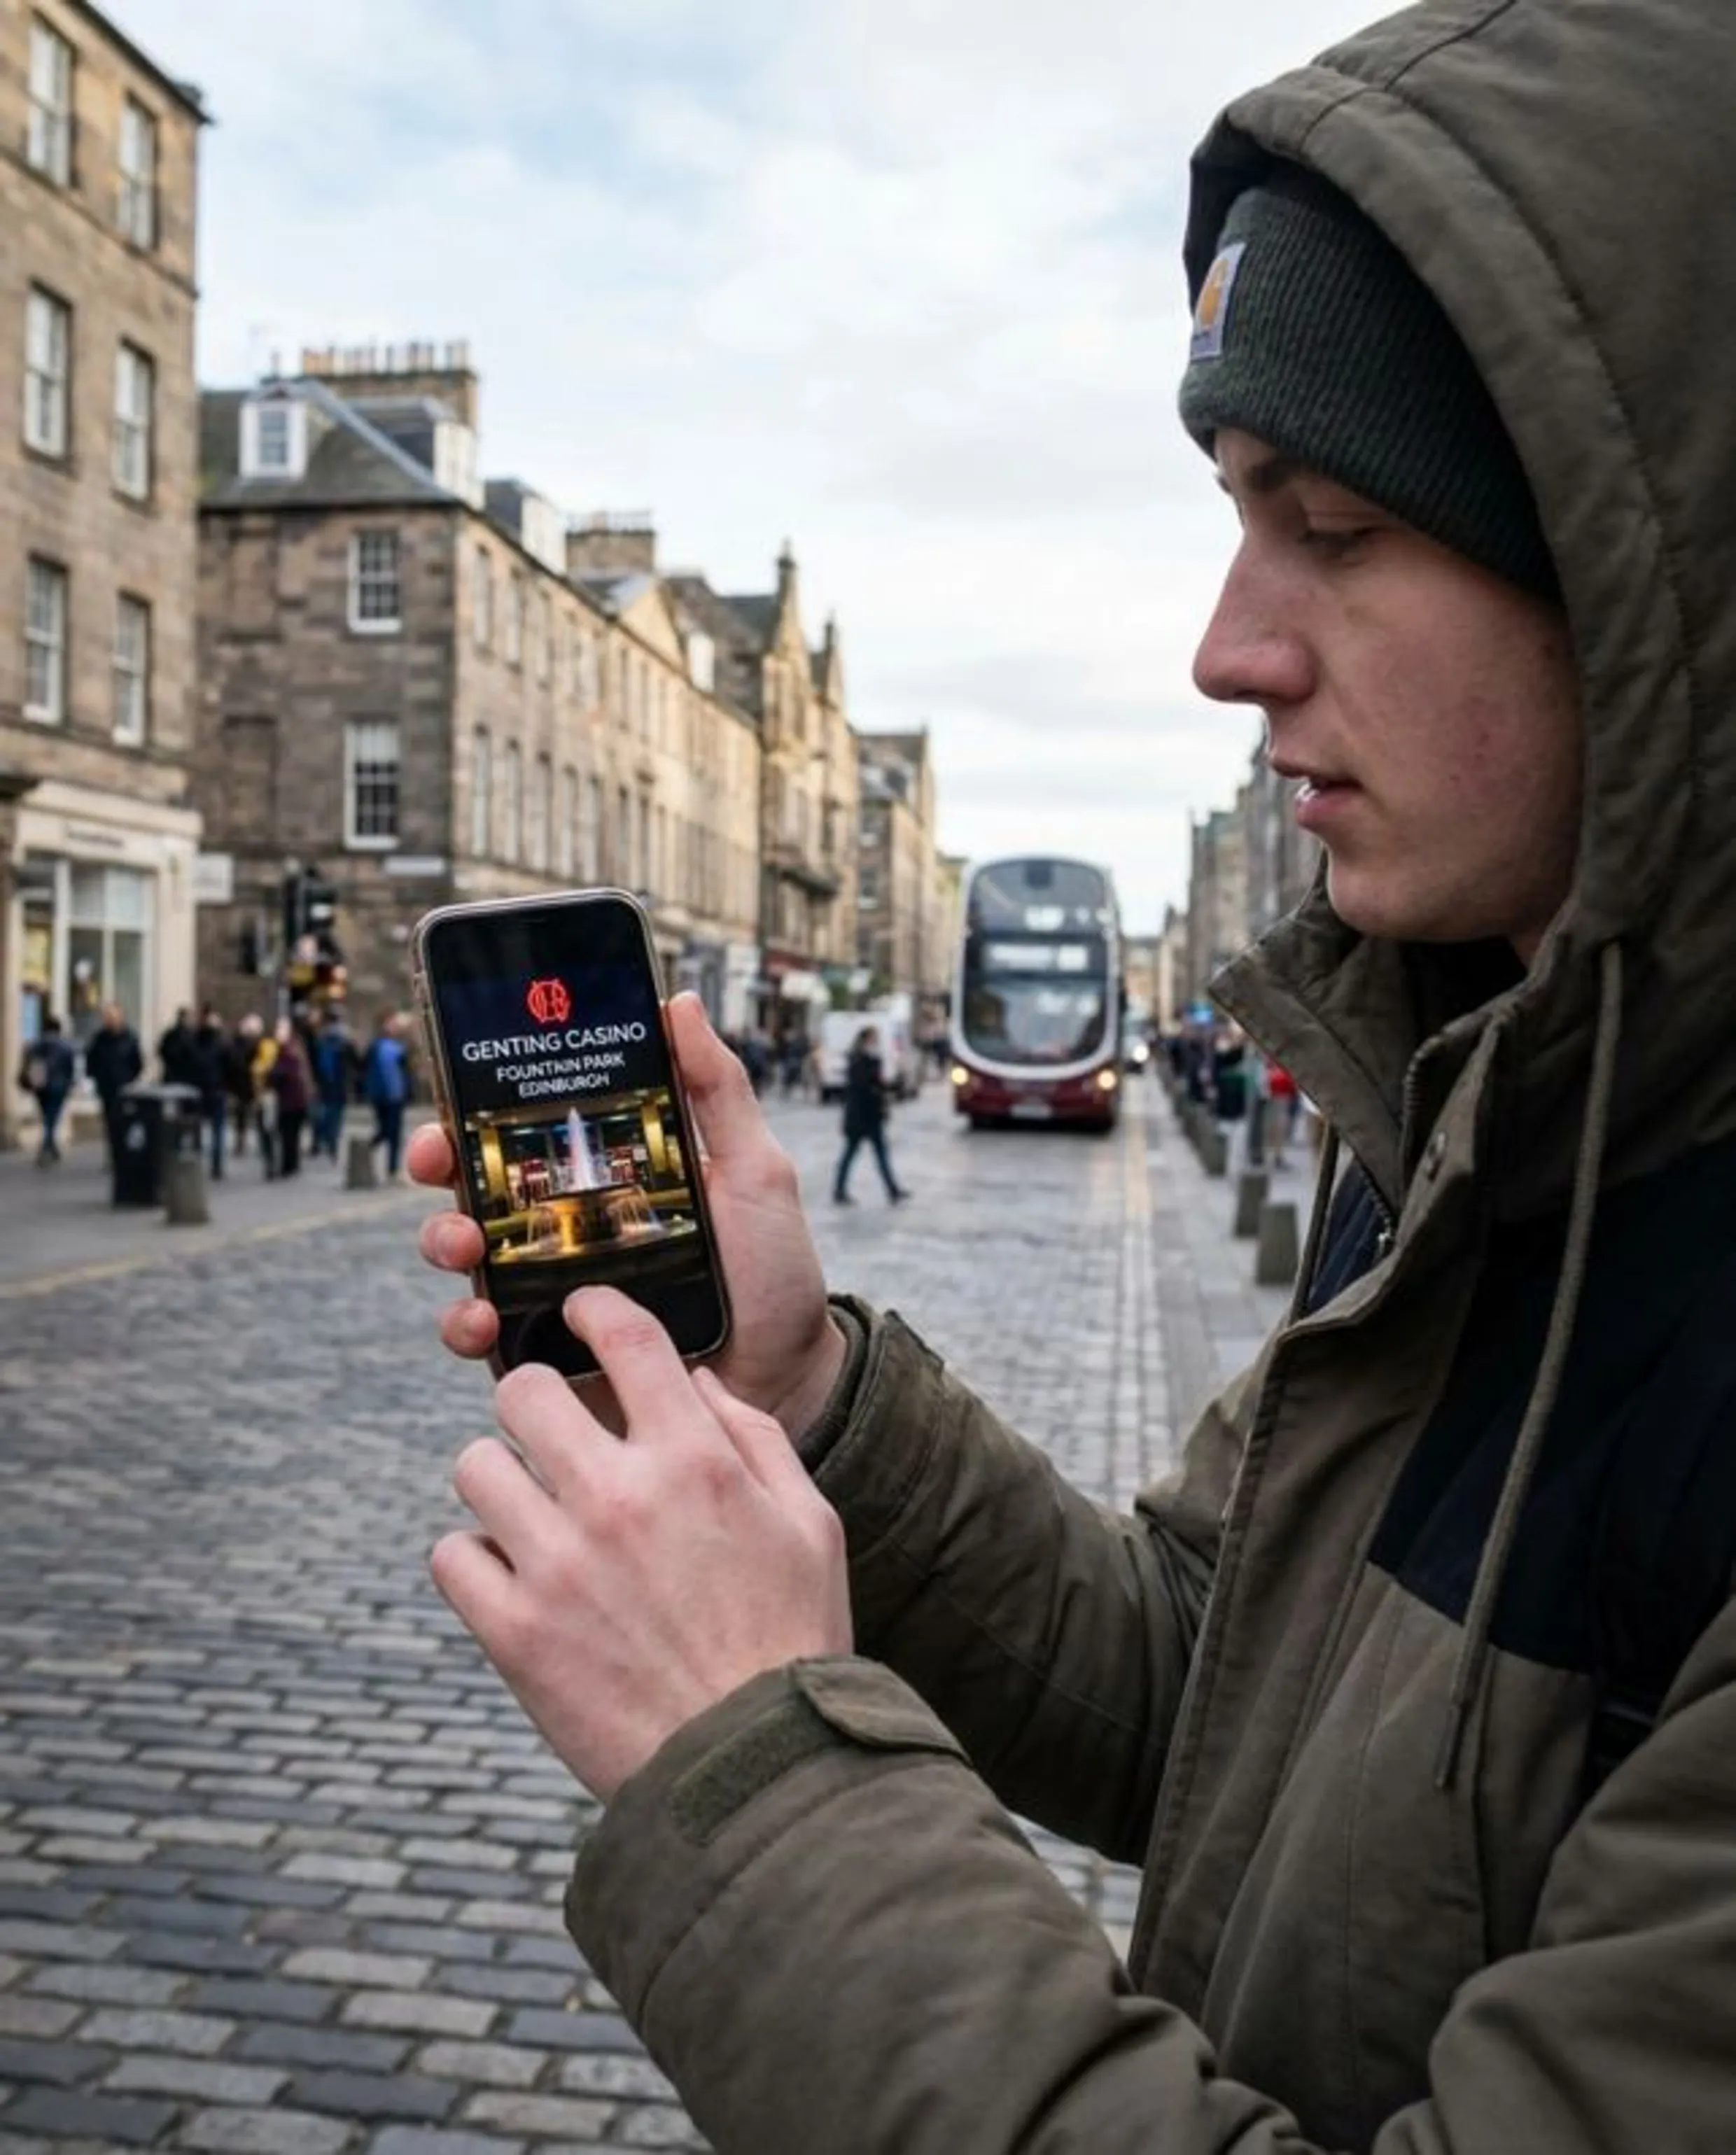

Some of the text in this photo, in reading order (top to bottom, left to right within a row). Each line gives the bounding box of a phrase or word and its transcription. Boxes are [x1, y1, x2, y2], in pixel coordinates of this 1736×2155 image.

[462, 1022, 646, 1061] GENTING CASINO
[496, 1052, 626, 1082] FOUNTAIN PARK
[519, 1072, 610, 1097] EDINBURGH
